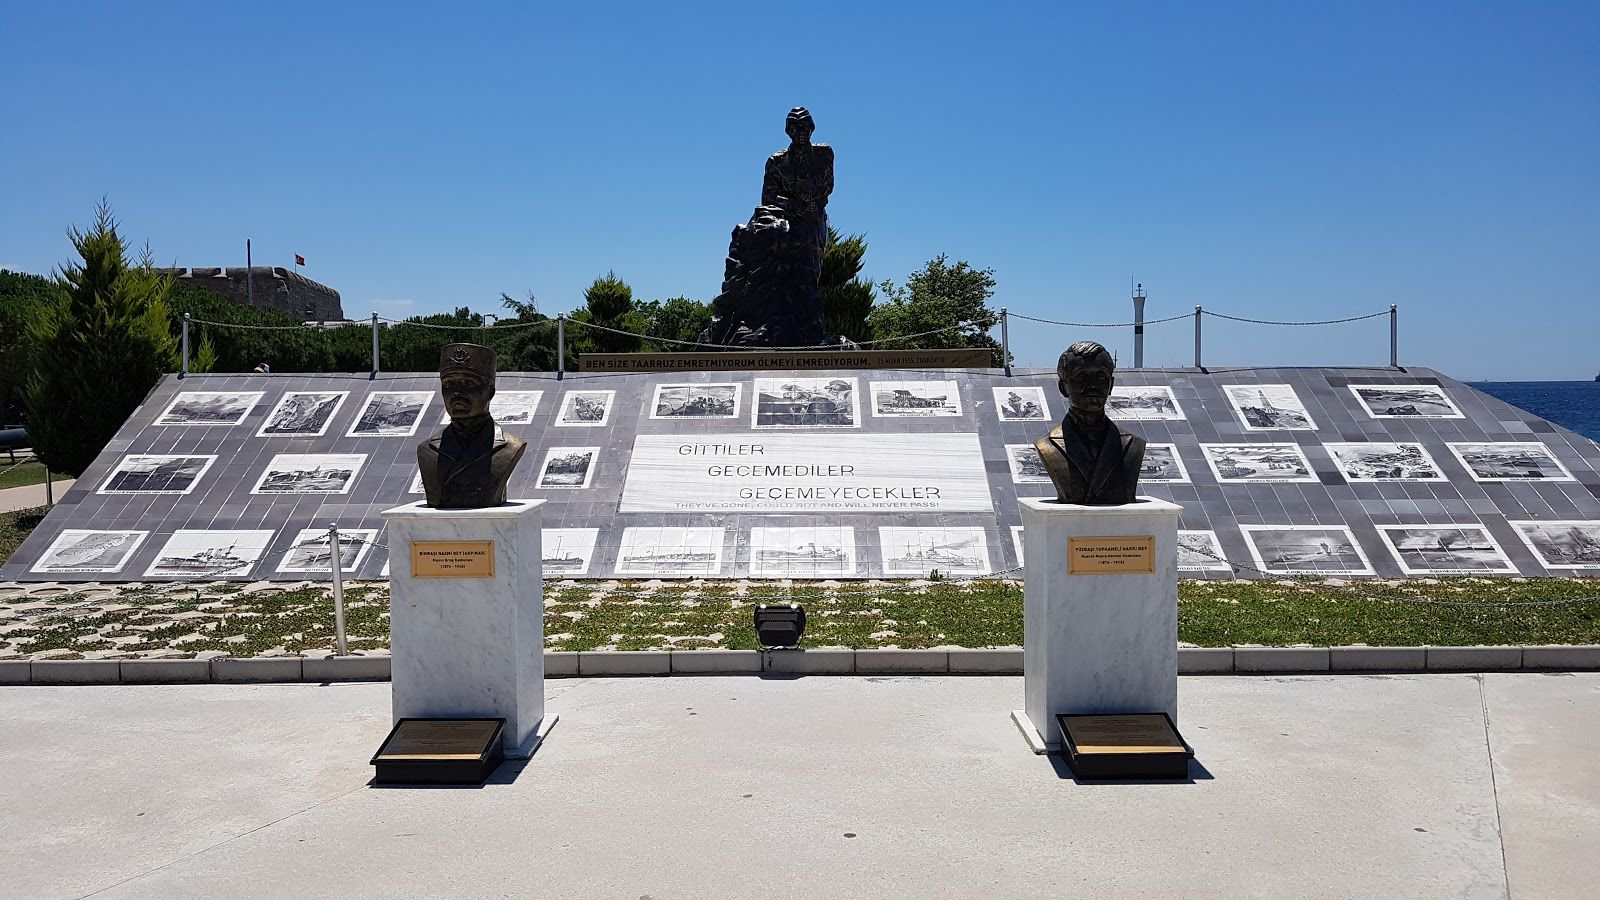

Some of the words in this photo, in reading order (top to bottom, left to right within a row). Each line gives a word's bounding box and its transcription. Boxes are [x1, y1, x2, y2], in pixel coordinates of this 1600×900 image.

[586, 360, 605, 368] BEN
[607, 359, 629, 368] SİZE
[631, 360, 675, 368] TAARRUZ
[677, 359, 756, 368] EMRETMİYORUM
[758, 358, 794, 367] ÖLMEYİ
[678, 443, 764, 455] GİTTİLER
[739, 487, 941, 501] GEÇEMEYECEKLER
